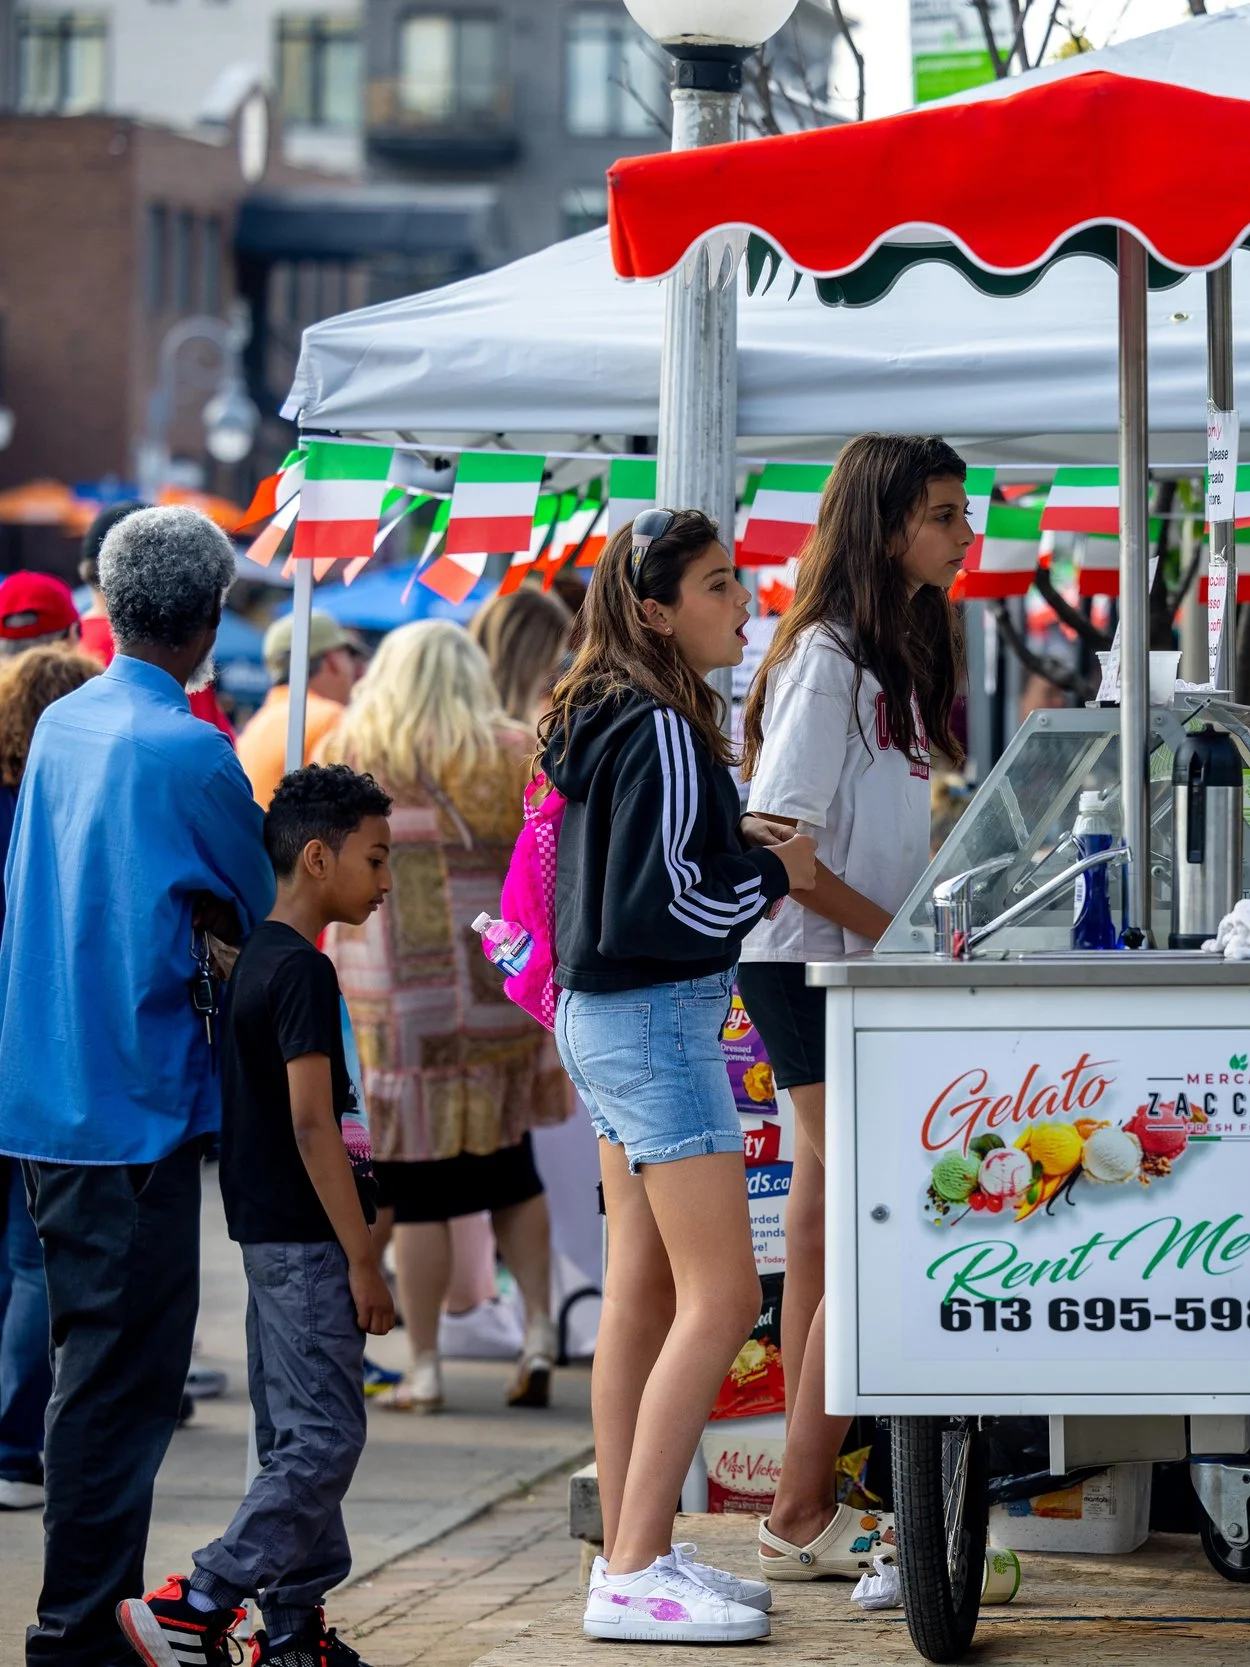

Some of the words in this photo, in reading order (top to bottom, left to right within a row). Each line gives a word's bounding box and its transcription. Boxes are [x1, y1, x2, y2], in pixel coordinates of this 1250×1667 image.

[1209, 448, 1229, 463] please
[720, 1044, 752, 1054] Dressed
[921, 1053, 1120, 1158] Gelato
[1187, 1123, 1233, 1132] FRESH
[746, 1172, 790, 1194] ds.ca
[926, 1233, 1138, 1306] Rent
[940, 1297, 1032, 1332] 613
[716, 1450, 744, 1480] Miss
